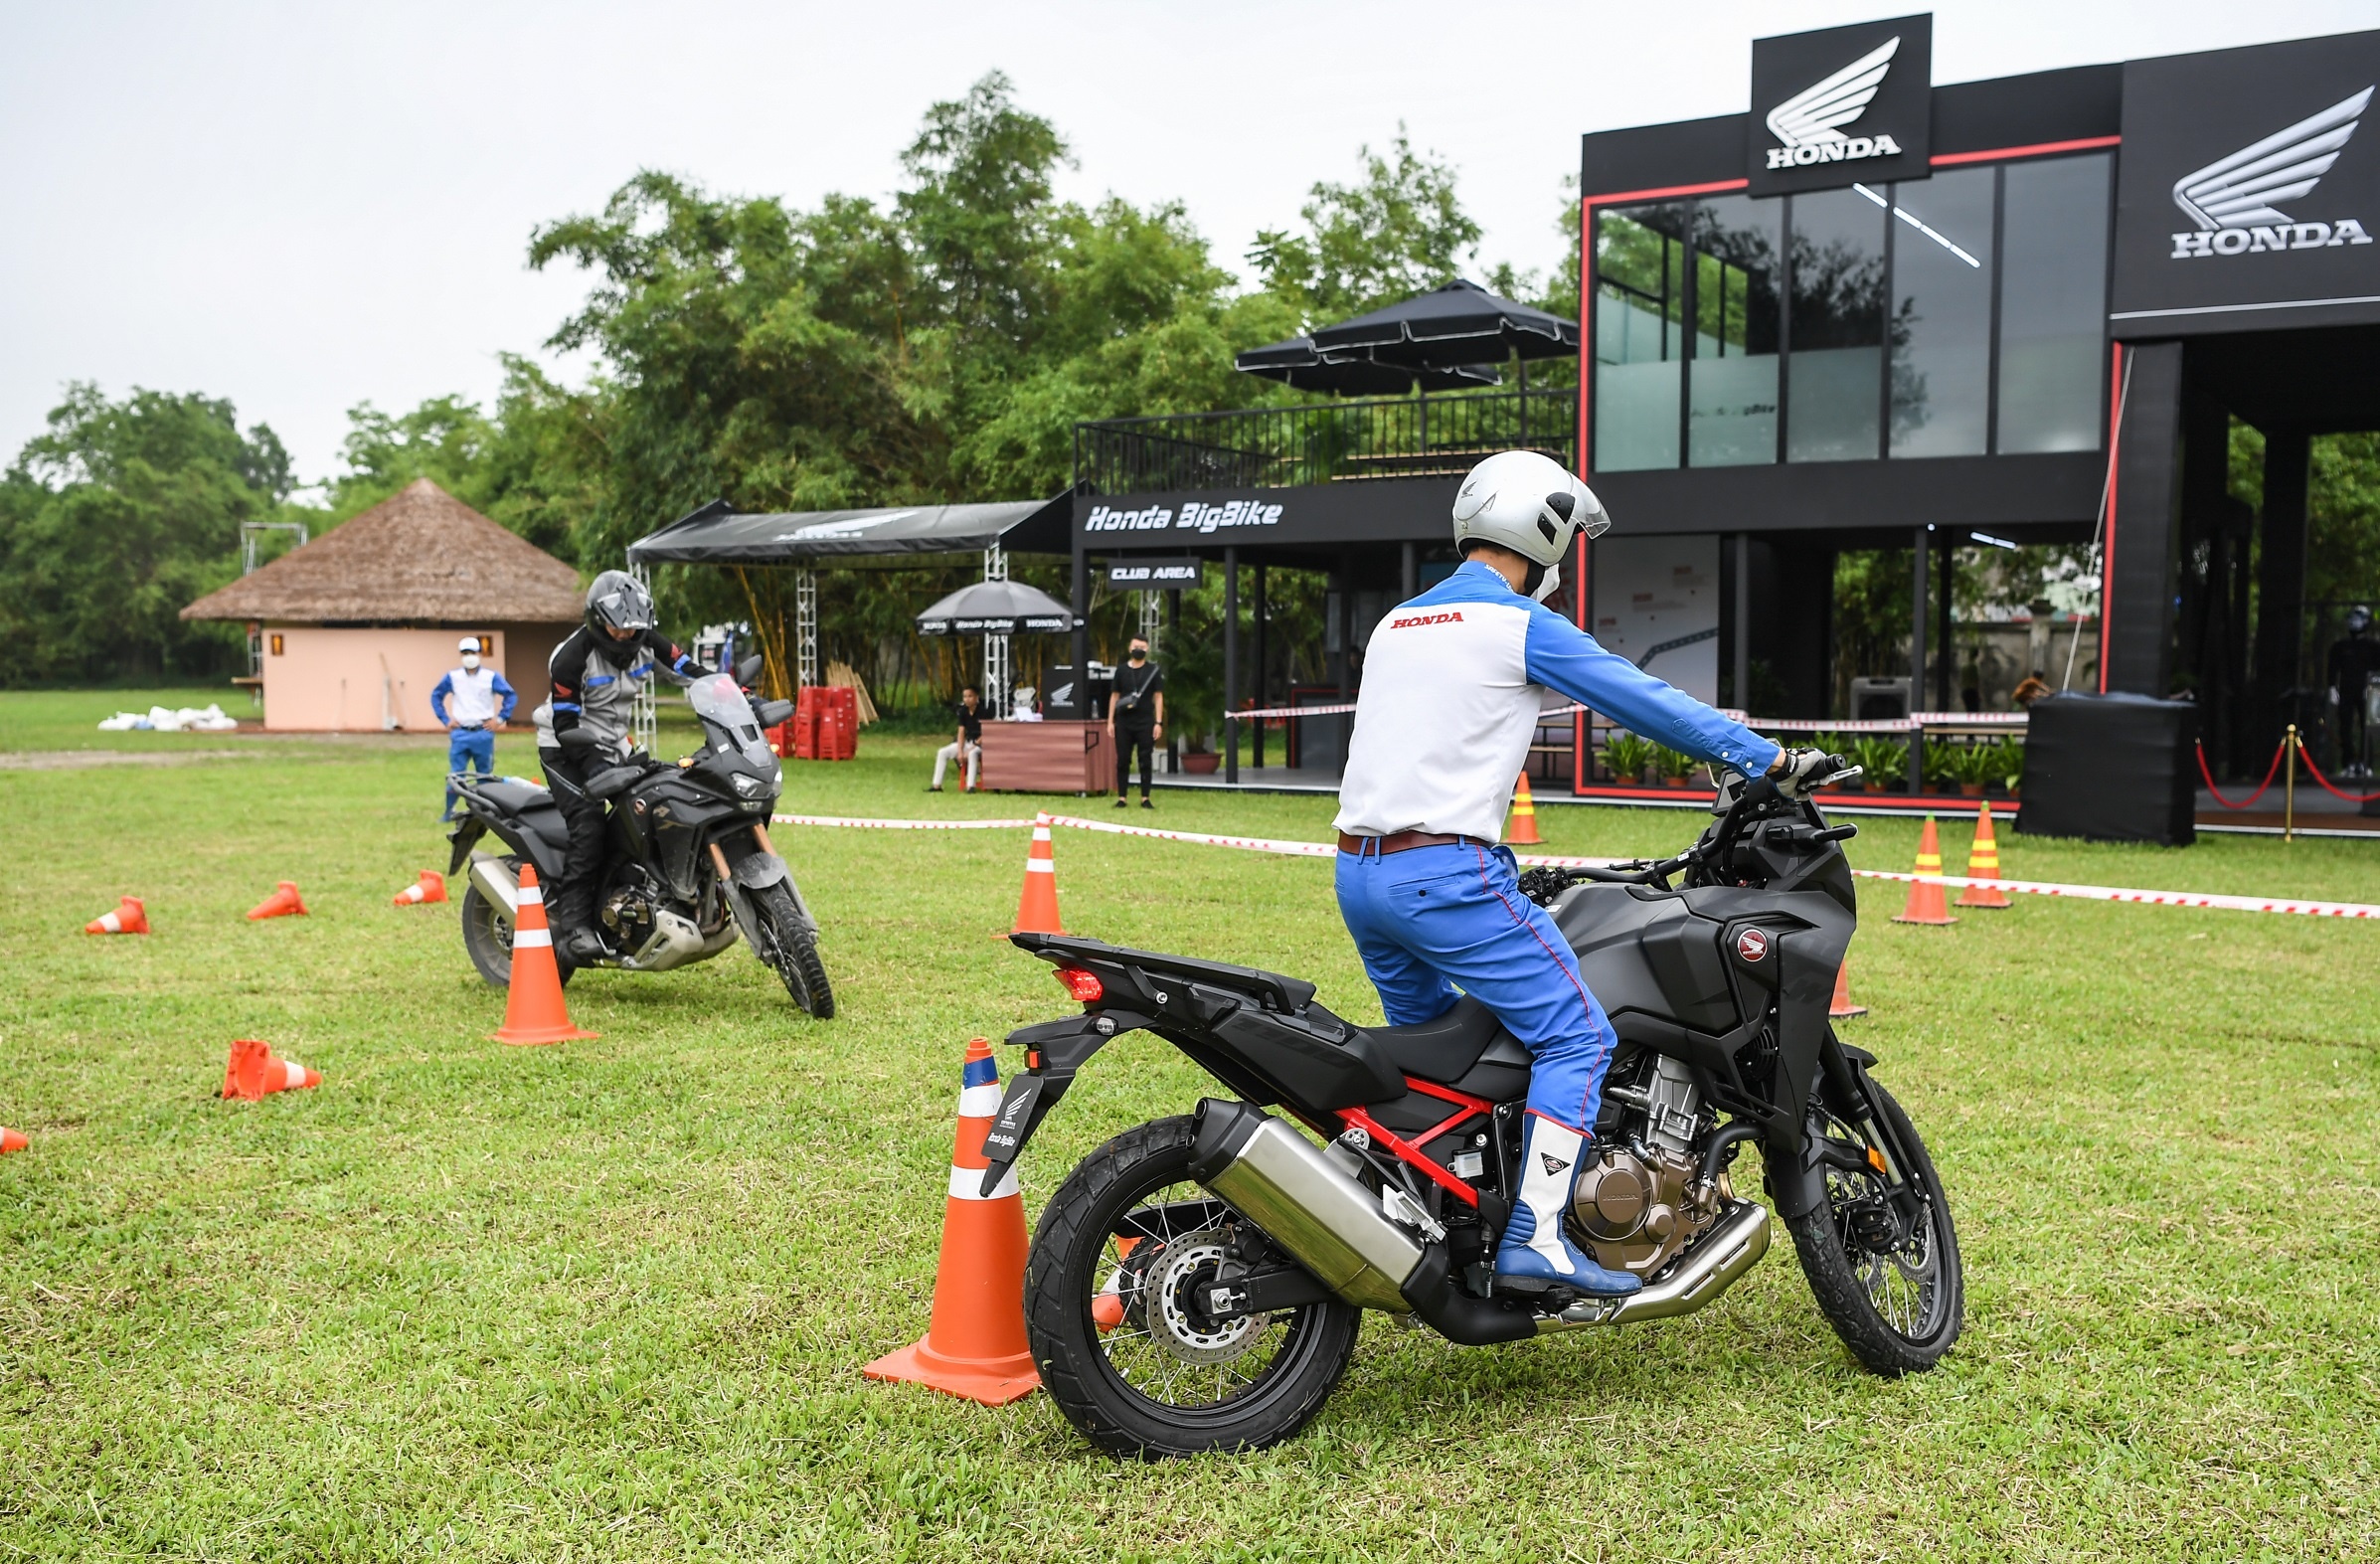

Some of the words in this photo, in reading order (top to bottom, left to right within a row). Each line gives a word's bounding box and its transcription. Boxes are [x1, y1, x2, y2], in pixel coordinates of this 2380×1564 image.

[1766, 134, 1903, 169] HONDA
[2170, 219, 2374, 260] HONDA
[1085, 504, 1173, 531] Honda
[1175, 500, 1283, 533] BigBike
[1110, 567, 1151, 580] CLUB
[1152, 566, 1196, 580] AREA
[1026, 618, 1064, 627] HONDA
[1390, 611, 1463, 628] HONDA
